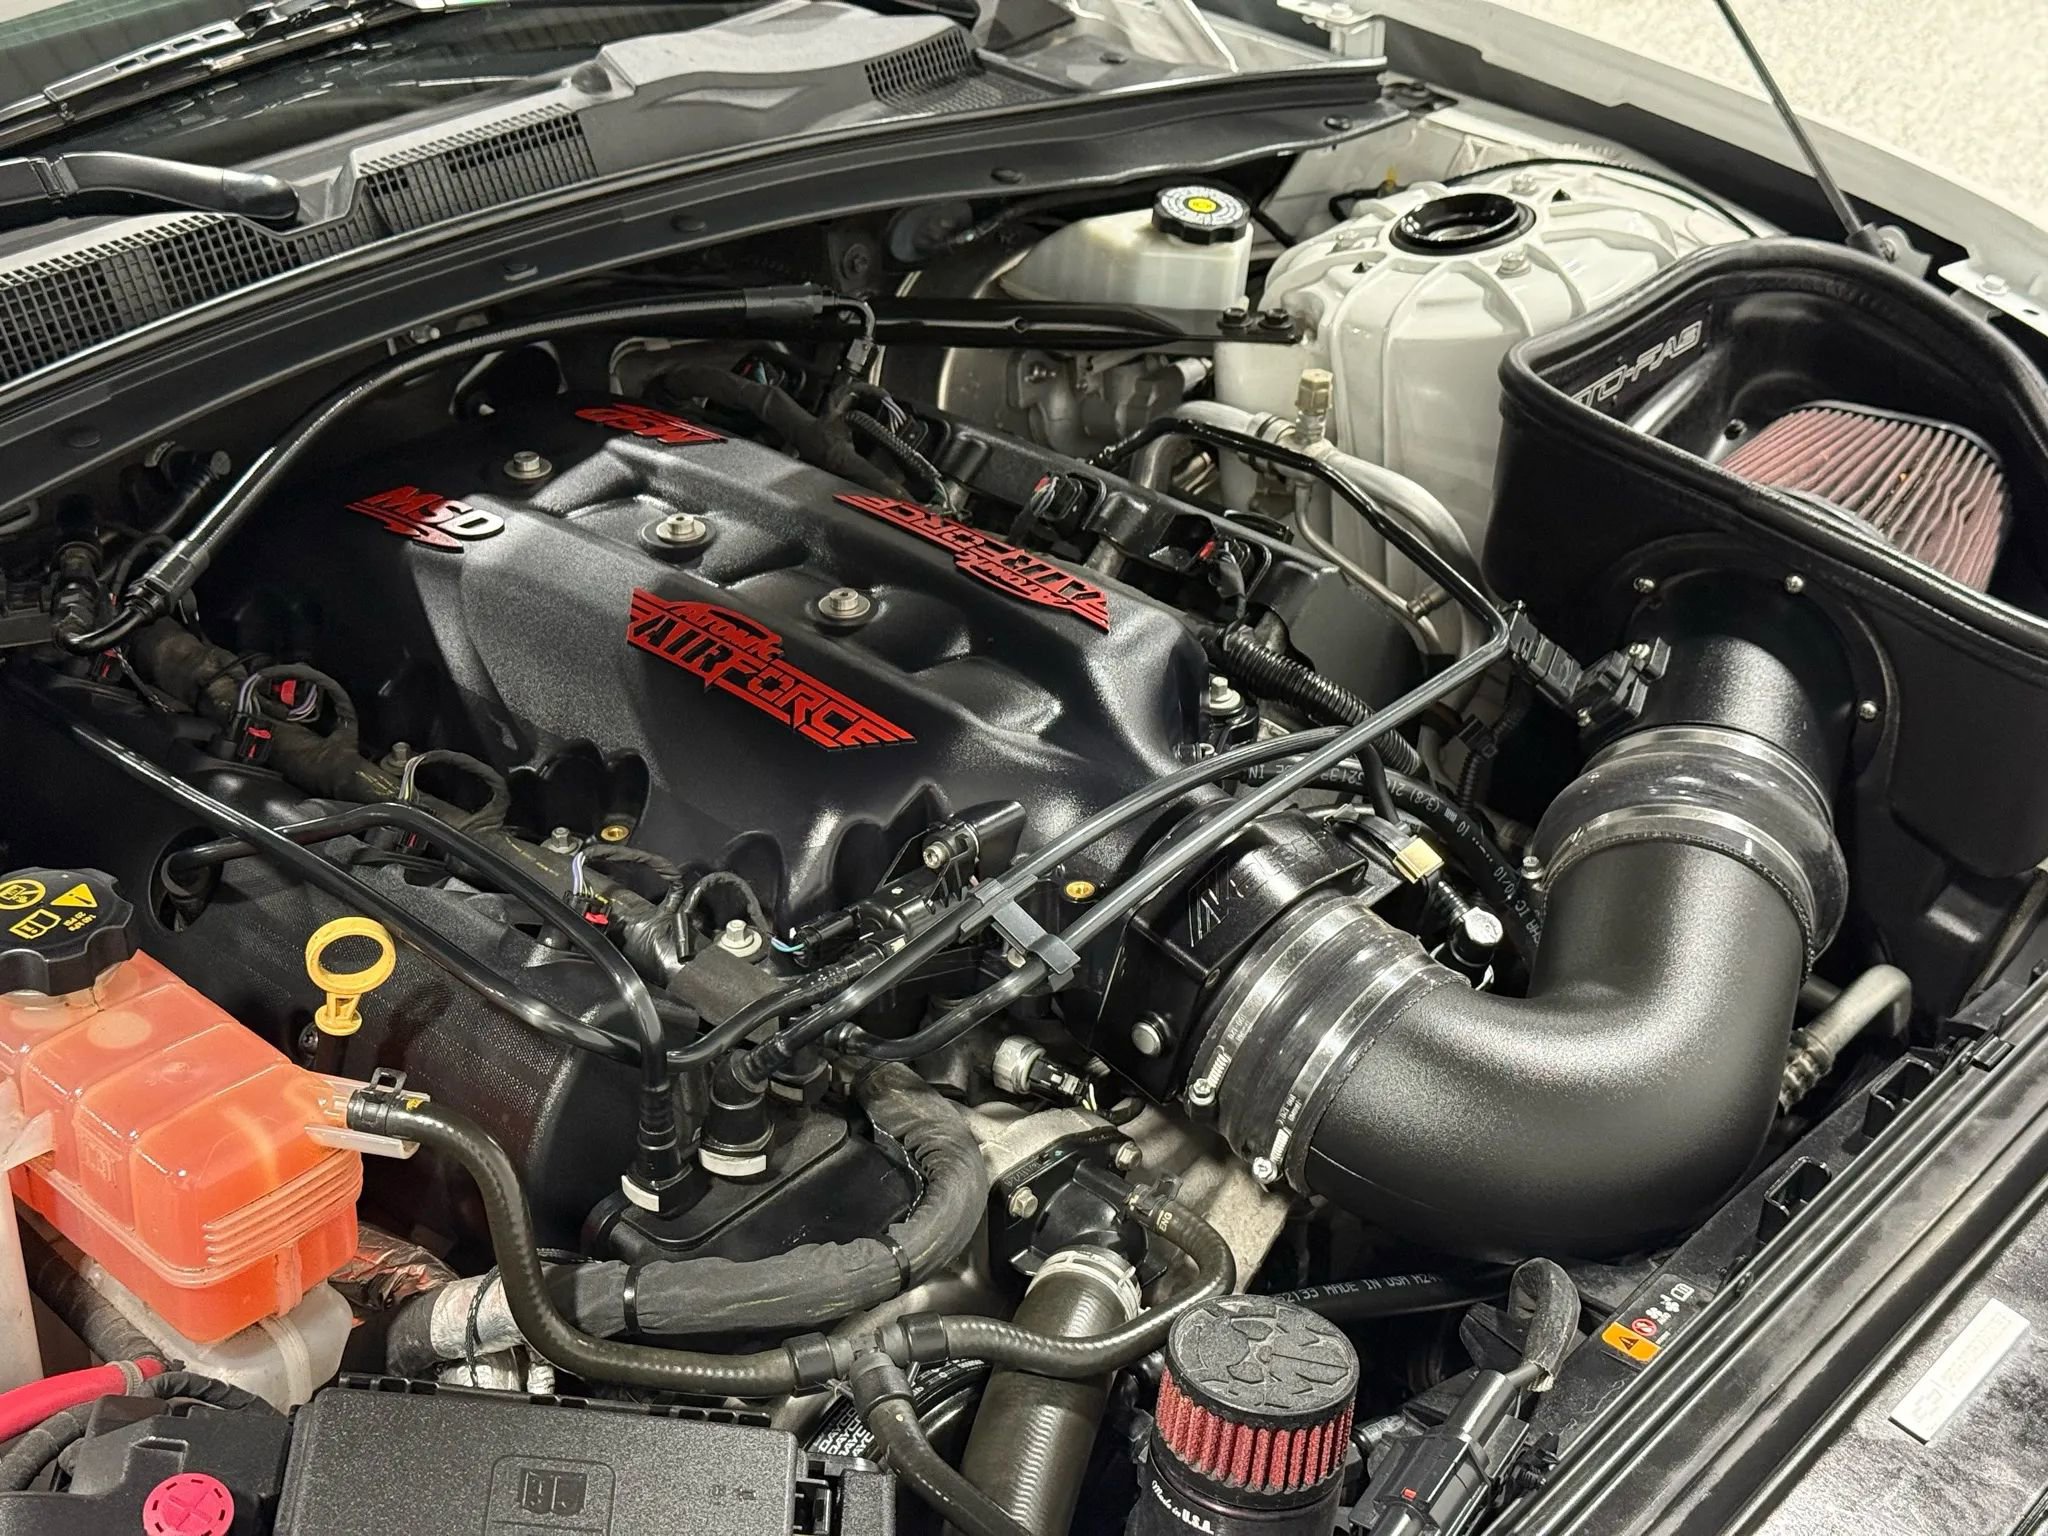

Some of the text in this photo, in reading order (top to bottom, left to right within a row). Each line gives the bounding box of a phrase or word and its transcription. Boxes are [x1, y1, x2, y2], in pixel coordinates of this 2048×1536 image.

[352, 485, 505, 544] MSD
[1322, 1281, 1359, 1296] MADE
[1364, 1278, 1382, 1290] IN
[1385, 1275, 1411, 1288] USA
